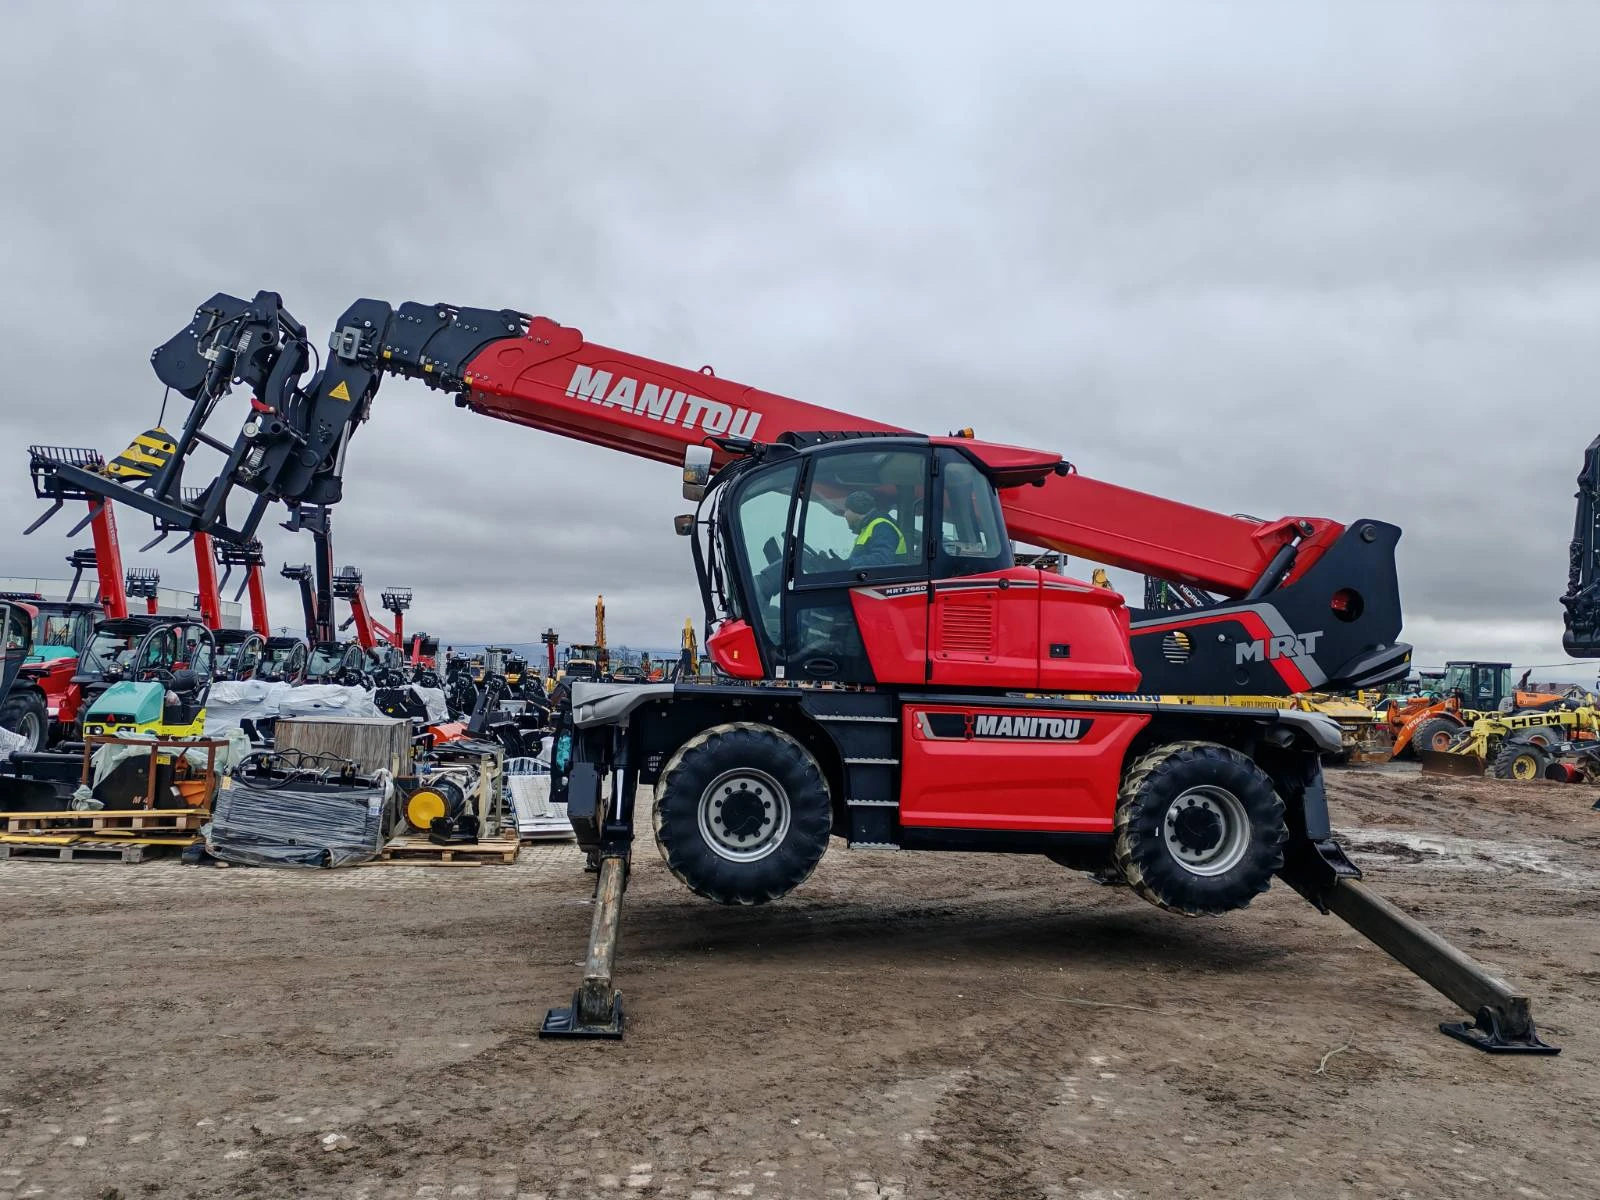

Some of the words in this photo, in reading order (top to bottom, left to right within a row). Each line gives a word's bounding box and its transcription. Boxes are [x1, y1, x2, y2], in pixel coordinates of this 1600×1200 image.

[565, 364, 763, 440] MANITOU
[1180, 584, 1204, 606] HIDRO
[1235, 630, 1324, 665] MRT
[975, 715, 1081, 739] MANITOU
[1406, 710, 1431, 730] HITACHI
[1511, 716, 1561, 728] HBM
